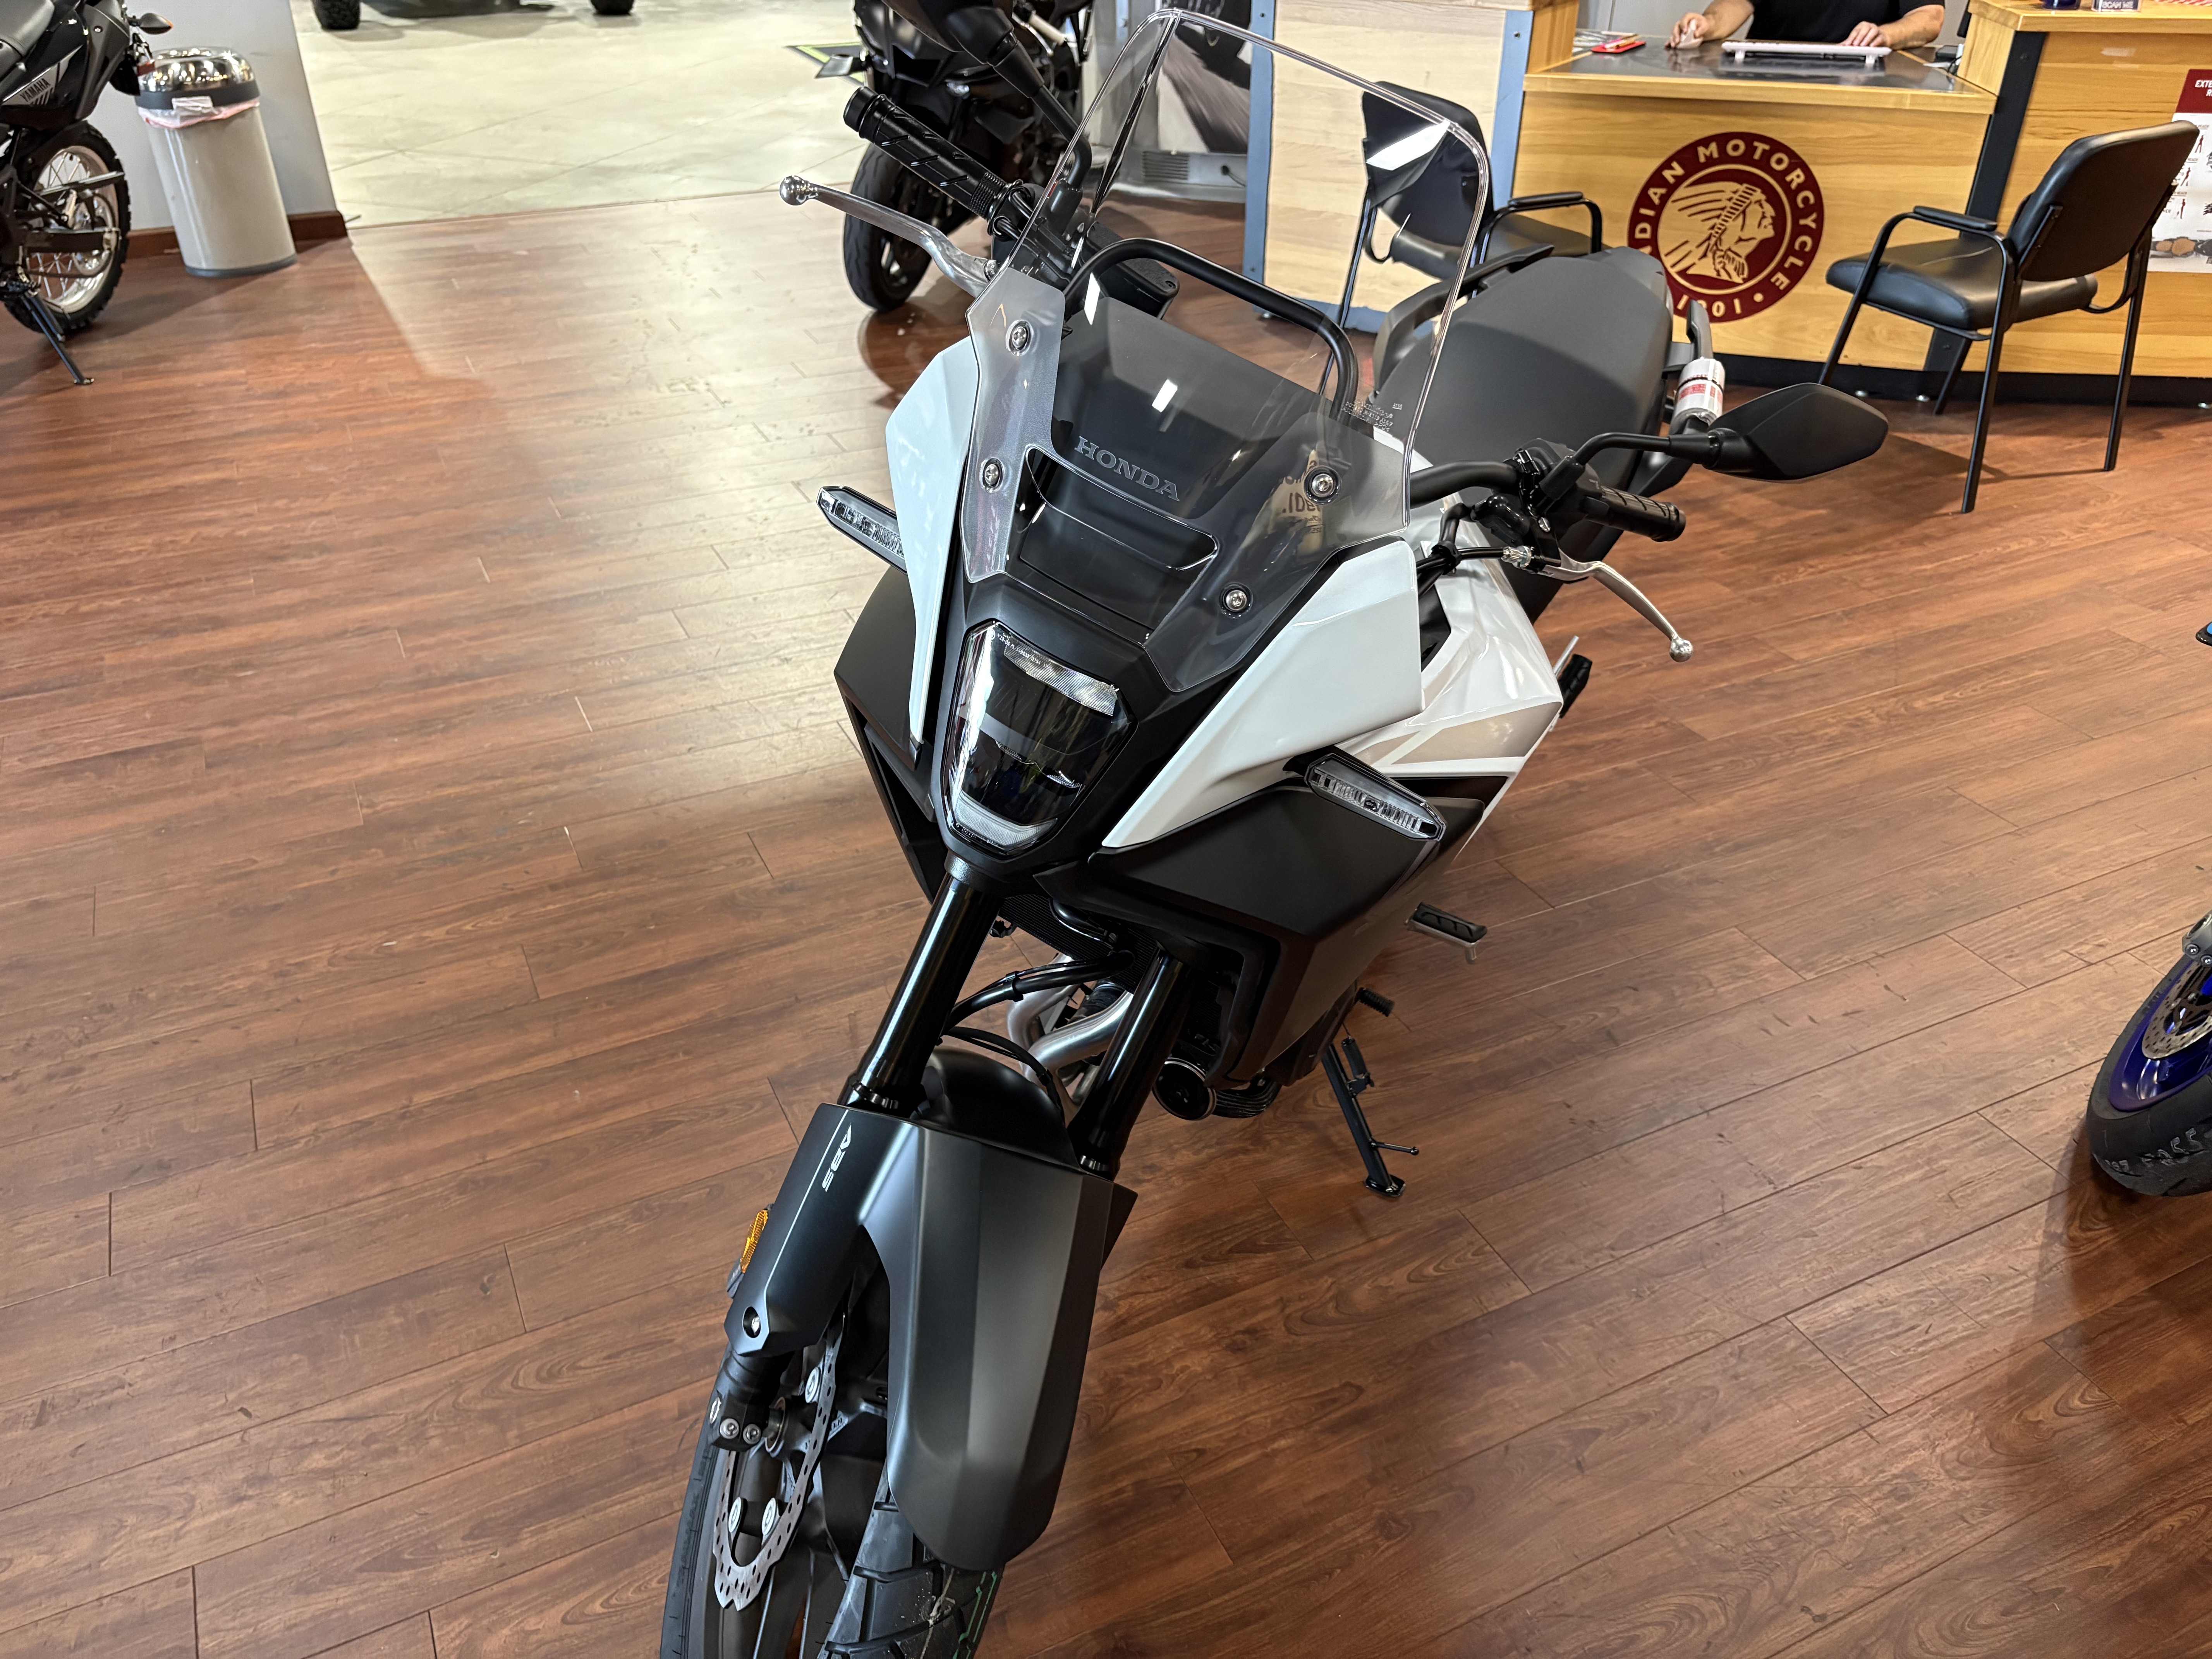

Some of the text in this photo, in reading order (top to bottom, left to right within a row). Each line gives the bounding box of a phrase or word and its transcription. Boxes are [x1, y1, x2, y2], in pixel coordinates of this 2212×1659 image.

[20, 78, 50, 102] YAMAHA
[1697, 139, 1817, 290] MOTORCYCLE
[1074, 436, 1180, 501] HONDA
[822, 1123, 852, 1192] ABS
